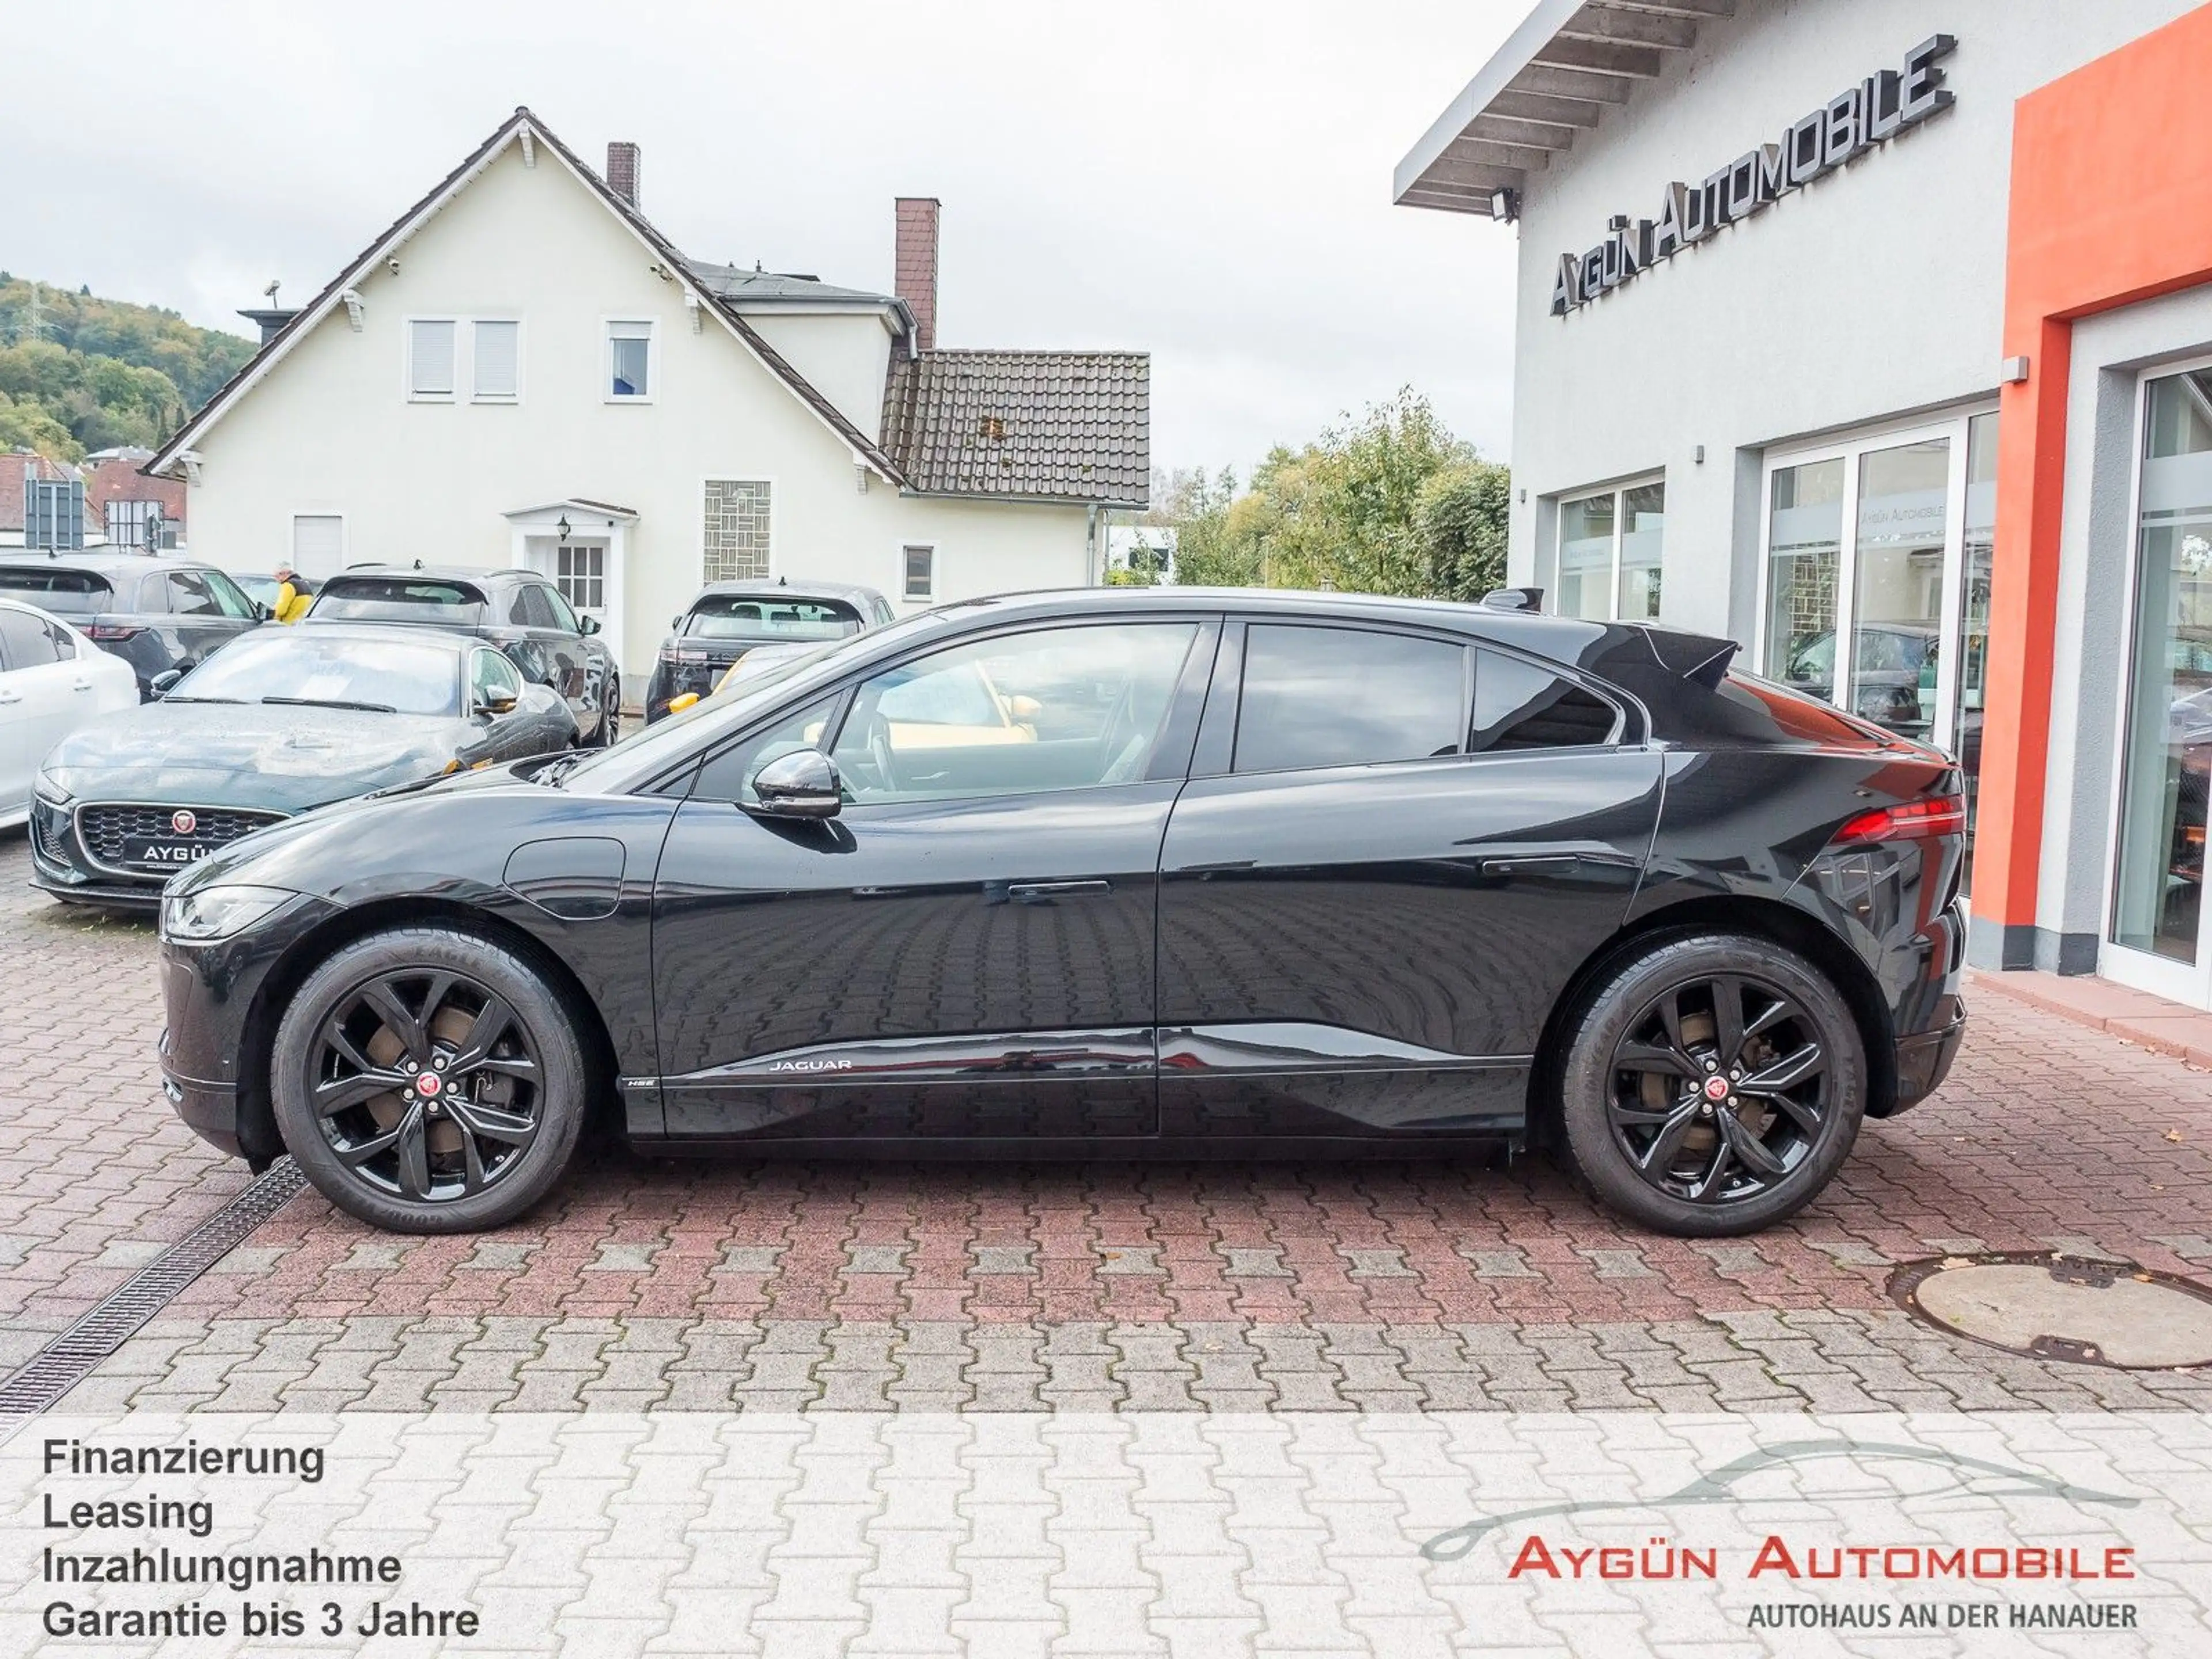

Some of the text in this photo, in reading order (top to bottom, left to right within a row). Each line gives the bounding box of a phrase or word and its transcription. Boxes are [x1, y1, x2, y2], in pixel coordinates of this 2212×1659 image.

[1550, 33, 1958, 316] AYGÜN AUTOMOBILE
[143, 844, 217, 861] AYGÜ
[769, 1060, 852, 1071] JAGUAR
